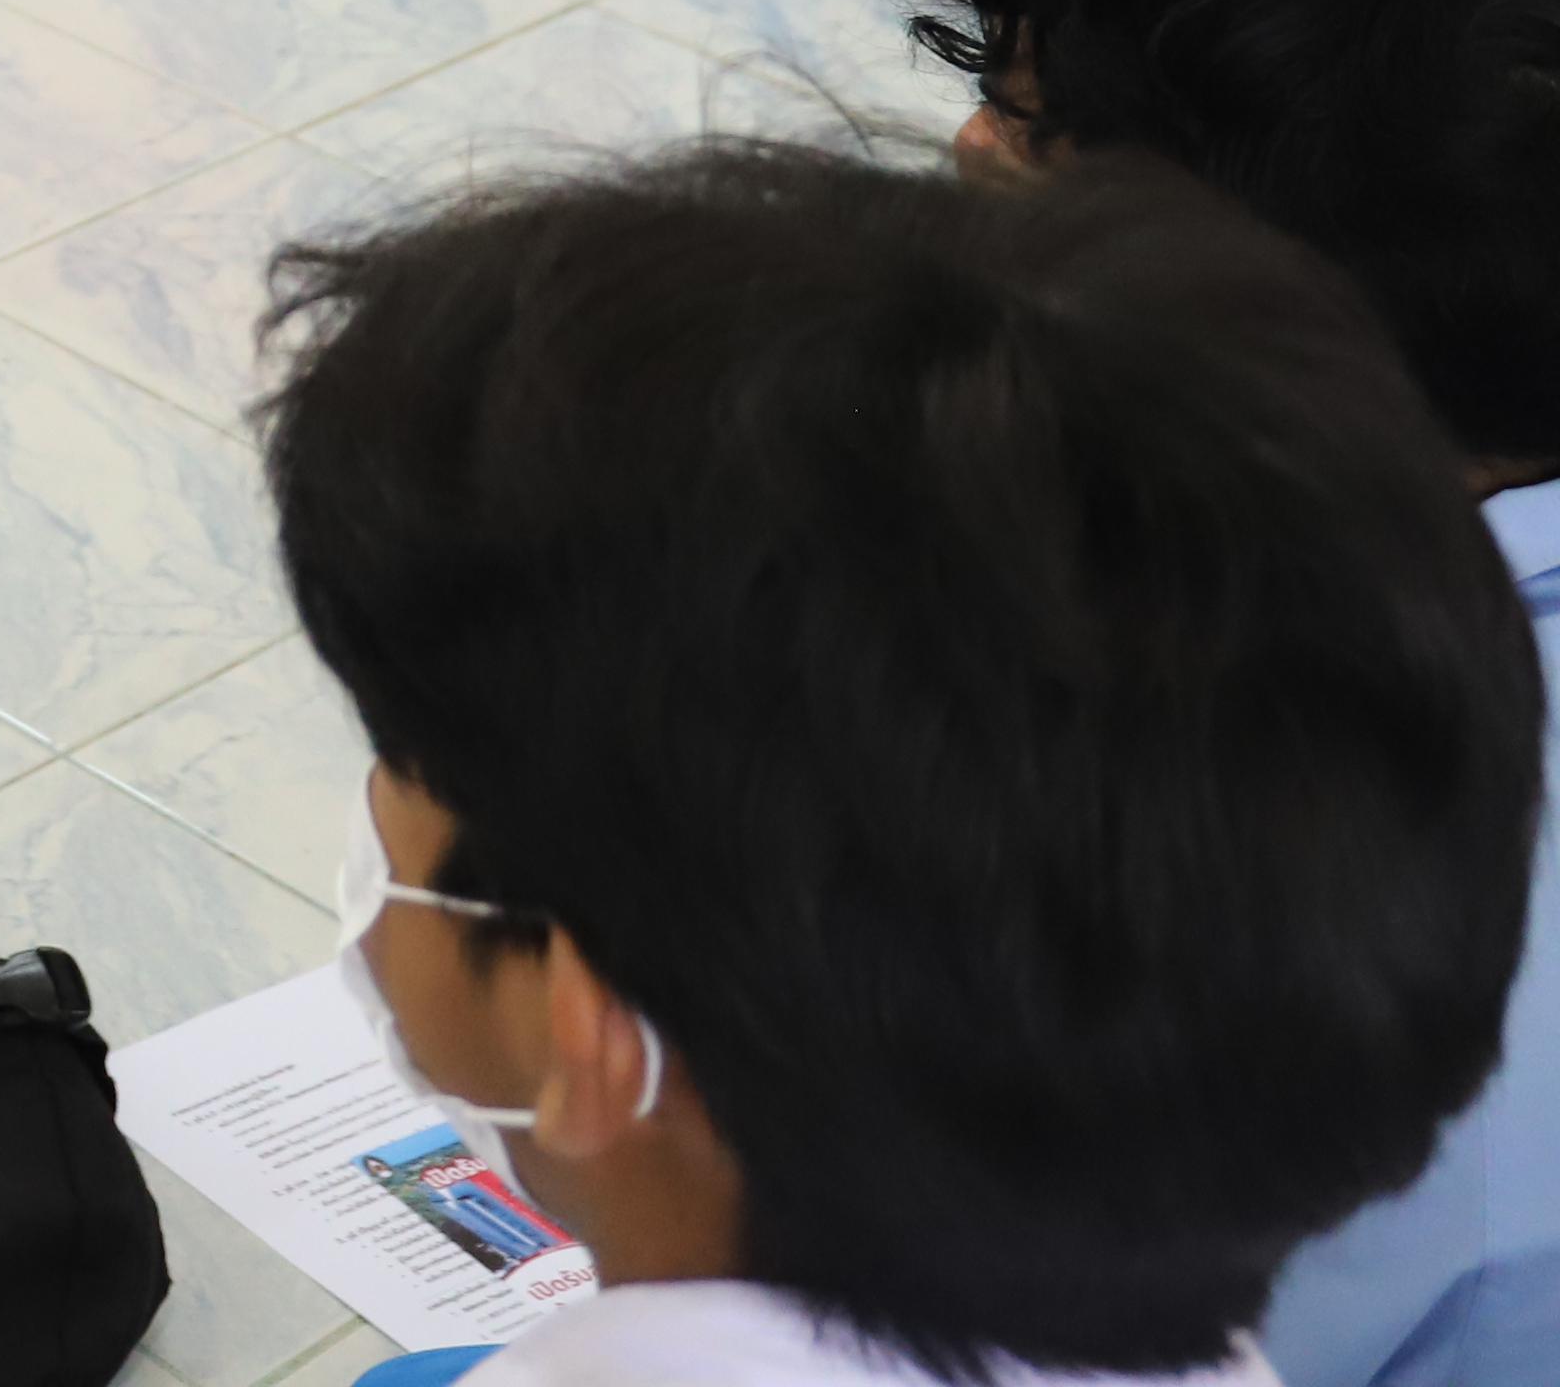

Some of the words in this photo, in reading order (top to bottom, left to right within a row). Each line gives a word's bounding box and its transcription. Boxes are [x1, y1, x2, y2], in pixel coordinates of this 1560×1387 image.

[422, 1157, 489, 1189] เปิดรับ
[528, 1268, 597, 1301] เปิดรับ
